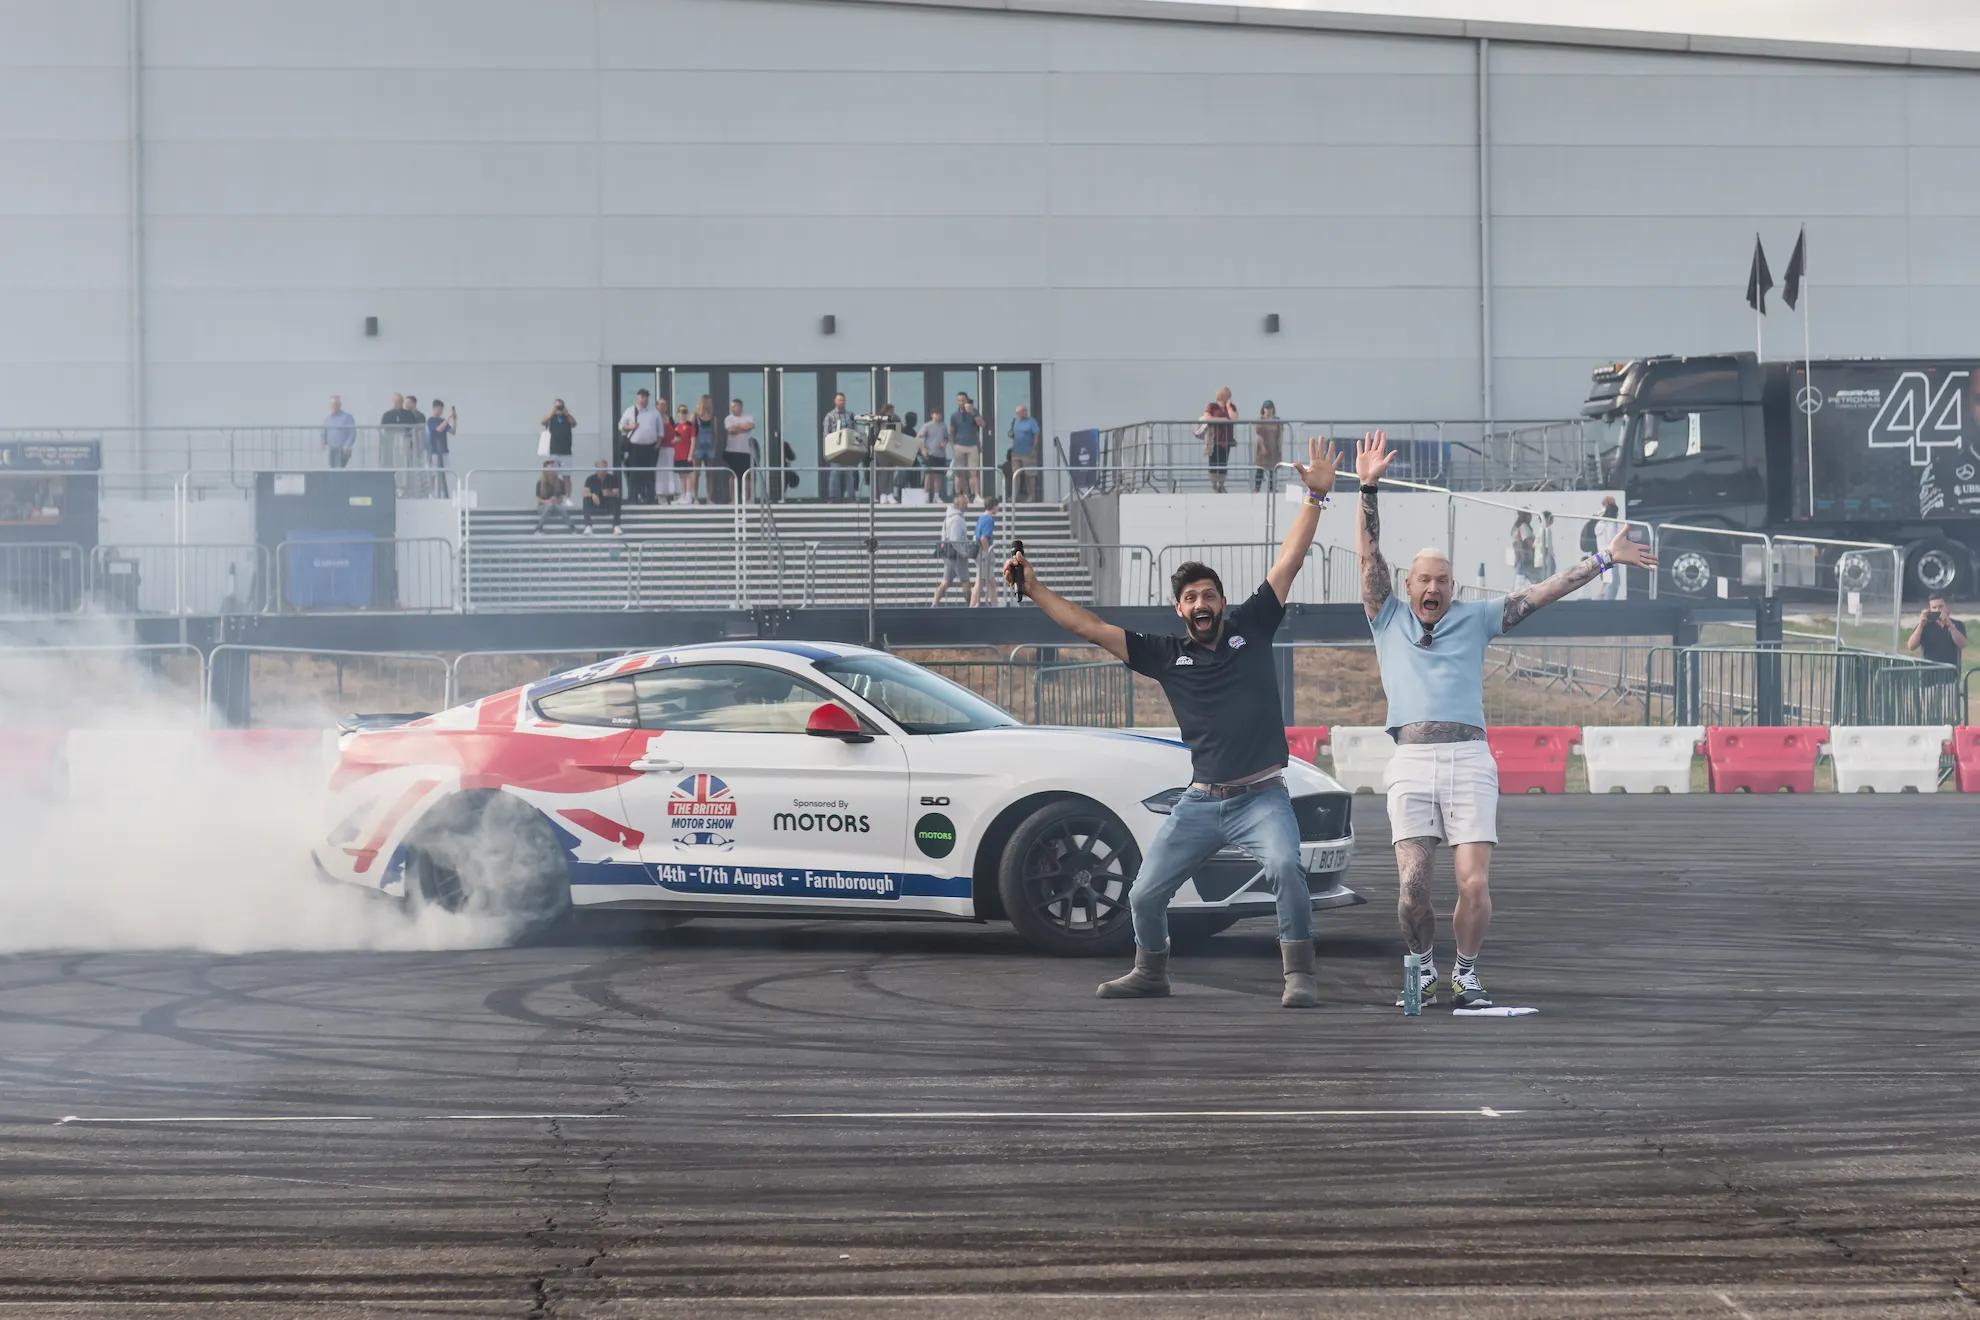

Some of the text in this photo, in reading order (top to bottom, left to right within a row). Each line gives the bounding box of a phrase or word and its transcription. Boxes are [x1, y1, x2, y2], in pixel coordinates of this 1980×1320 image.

[1868, 371, 1970, 466] 44
[793, 798, 849, 810] Sponsored By
[920, 796, 950, 806] 5.0
[673, 802, 732, 815] THE BRITISH
[671, 818, 735, 830] MOTOR SHOW
[656, 864, 687, 882] 14th
[733, 867, 785, 890] August
[804, 870, 894, 895] Farnborough
